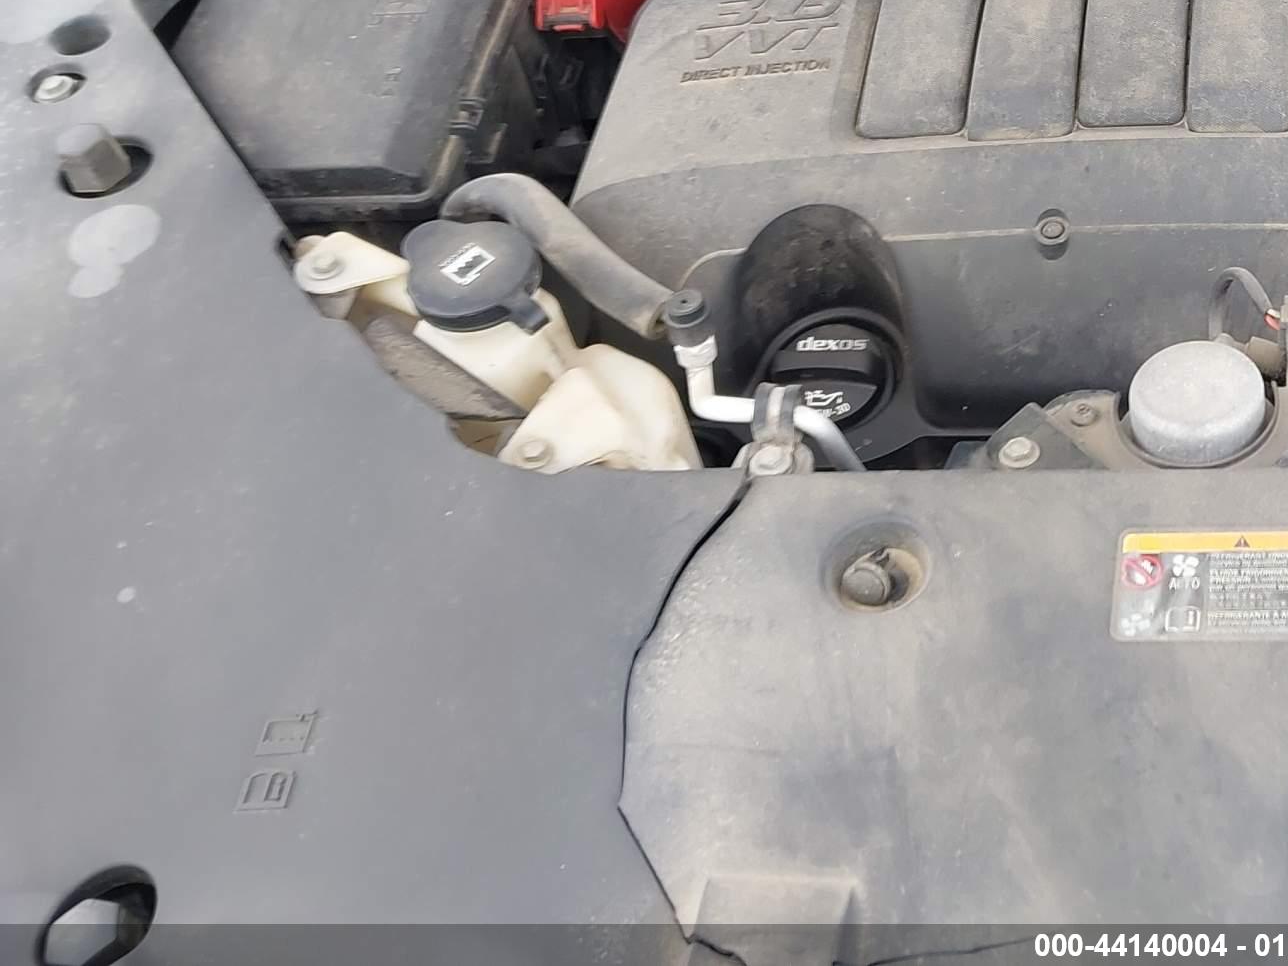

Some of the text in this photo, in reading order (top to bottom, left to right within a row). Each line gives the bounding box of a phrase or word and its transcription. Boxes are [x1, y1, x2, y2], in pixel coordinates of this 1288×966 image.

[693, 21, 840, 62] VVT
[680, 57, 832, 84] DIRECT INJECTION
[795, 336, 870, 352] dexos
